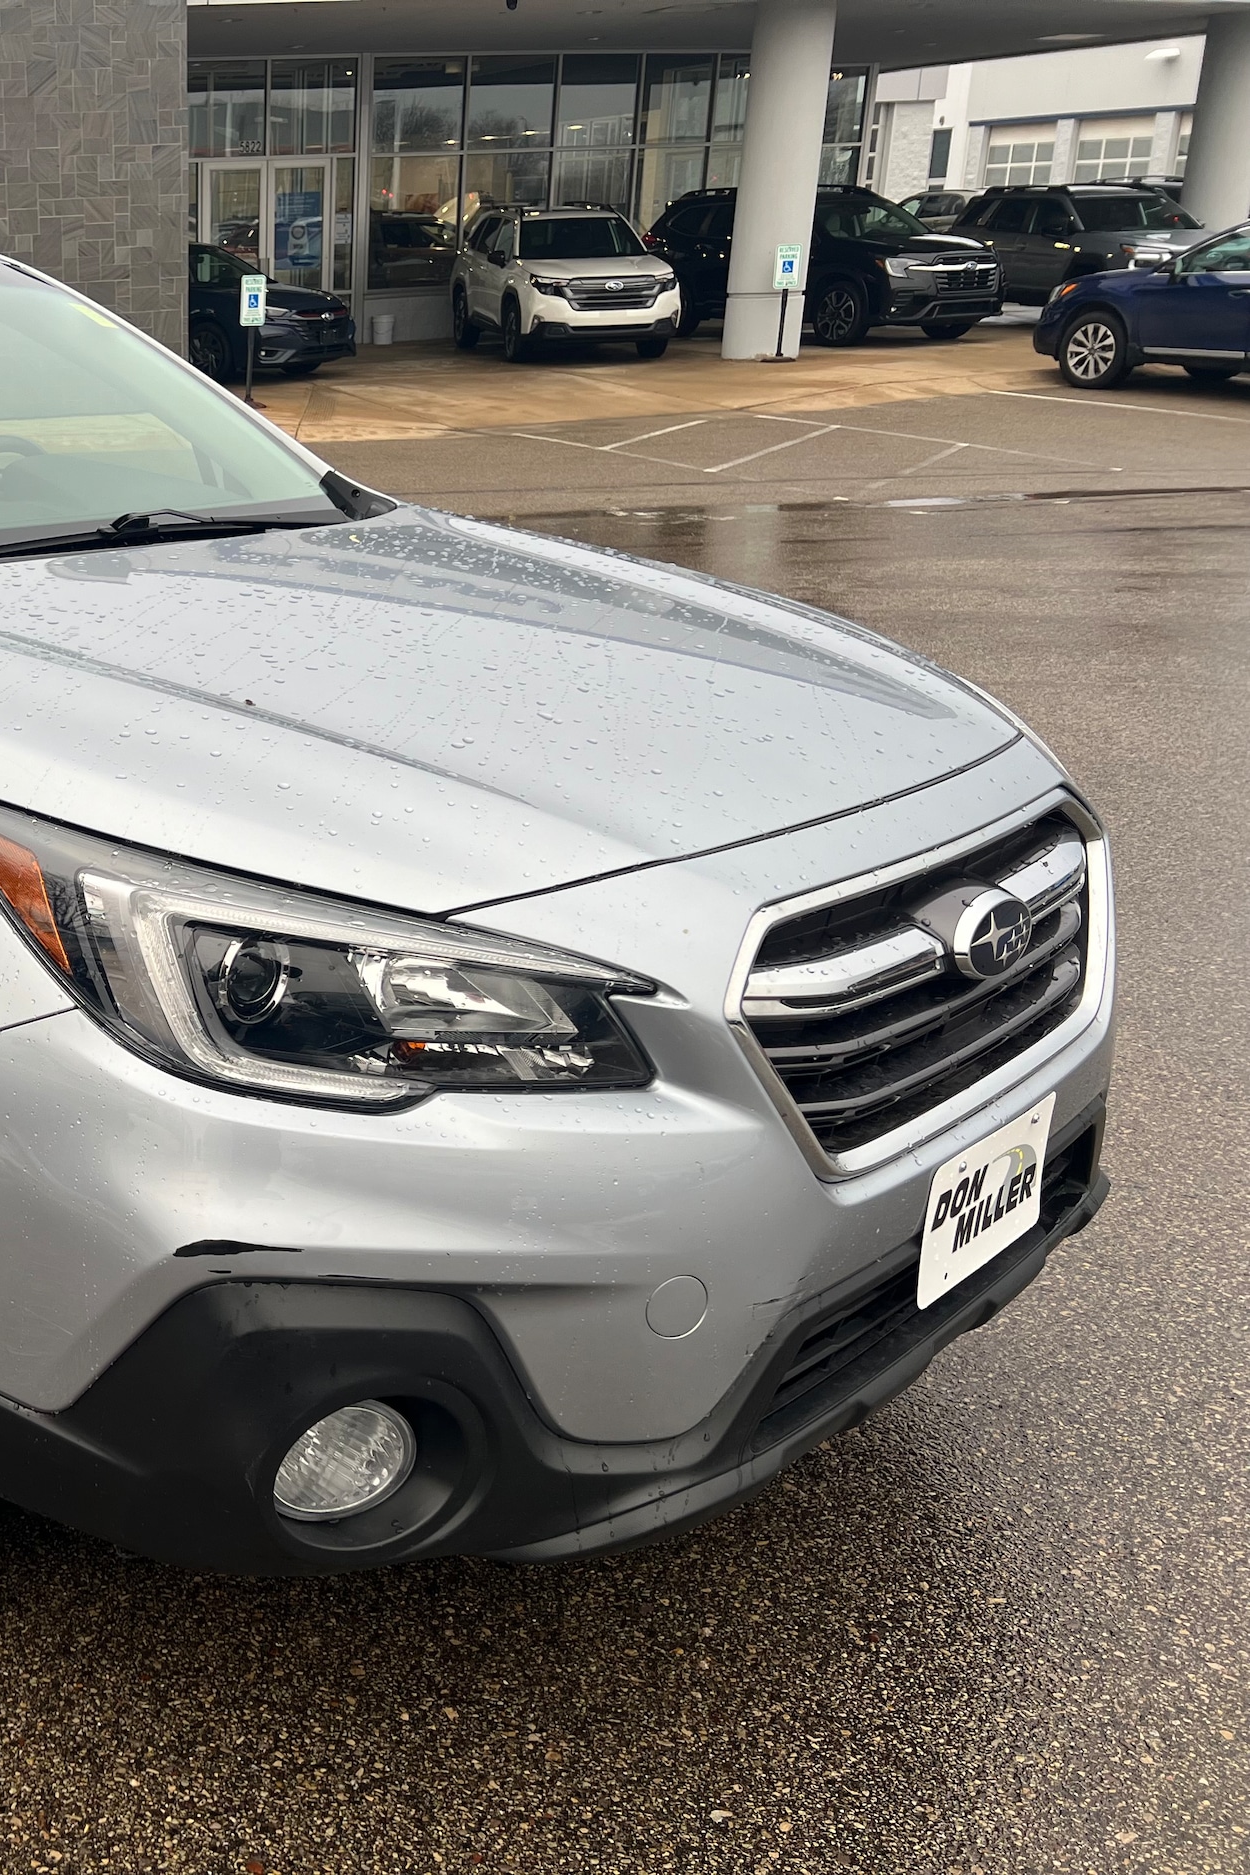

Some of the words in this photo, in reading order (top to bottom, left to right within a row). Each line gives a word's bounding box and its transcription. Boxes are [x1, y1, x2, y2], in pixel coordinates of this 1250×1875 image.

[239, 140, 262, 153] 5822
[930, 1162, 990, 1233] DON
[951, 1162, 1037, 1254] MILLER
